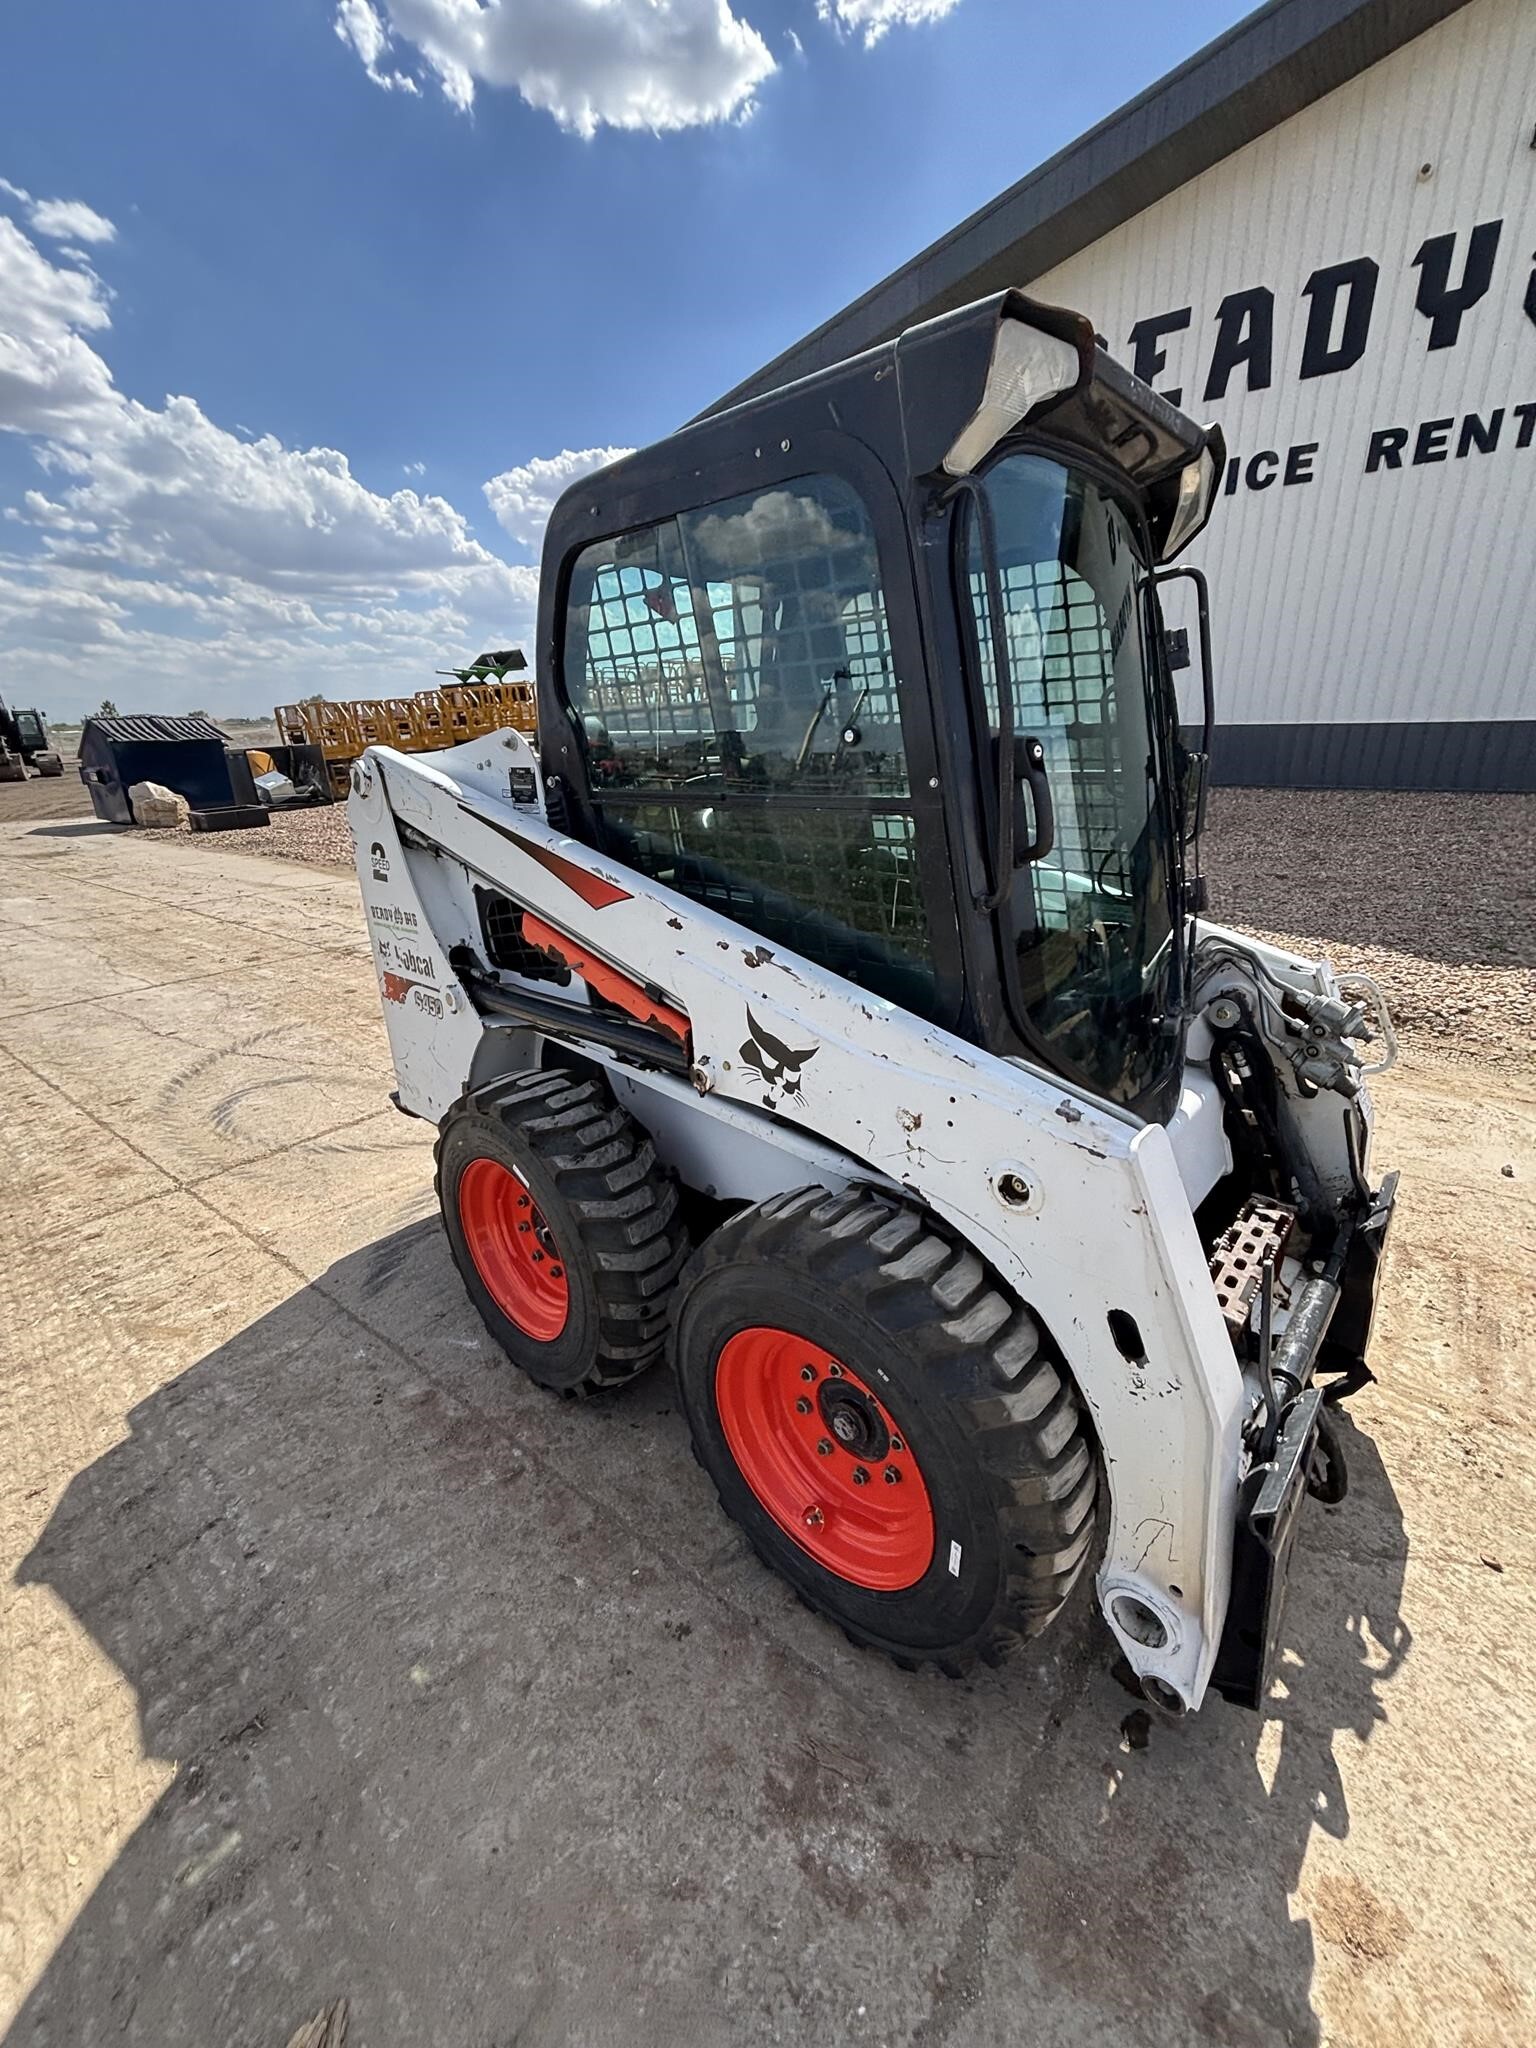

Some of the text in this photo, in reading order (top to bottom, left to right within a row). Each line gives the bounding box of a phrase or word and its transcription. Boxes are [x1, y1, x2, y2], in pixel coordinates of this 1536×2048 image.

[1094, 219, 1503, 408] EADY
[1224, 402, 1536, 496] ICE RENT
[371, 857, 391, 871] SPEED
